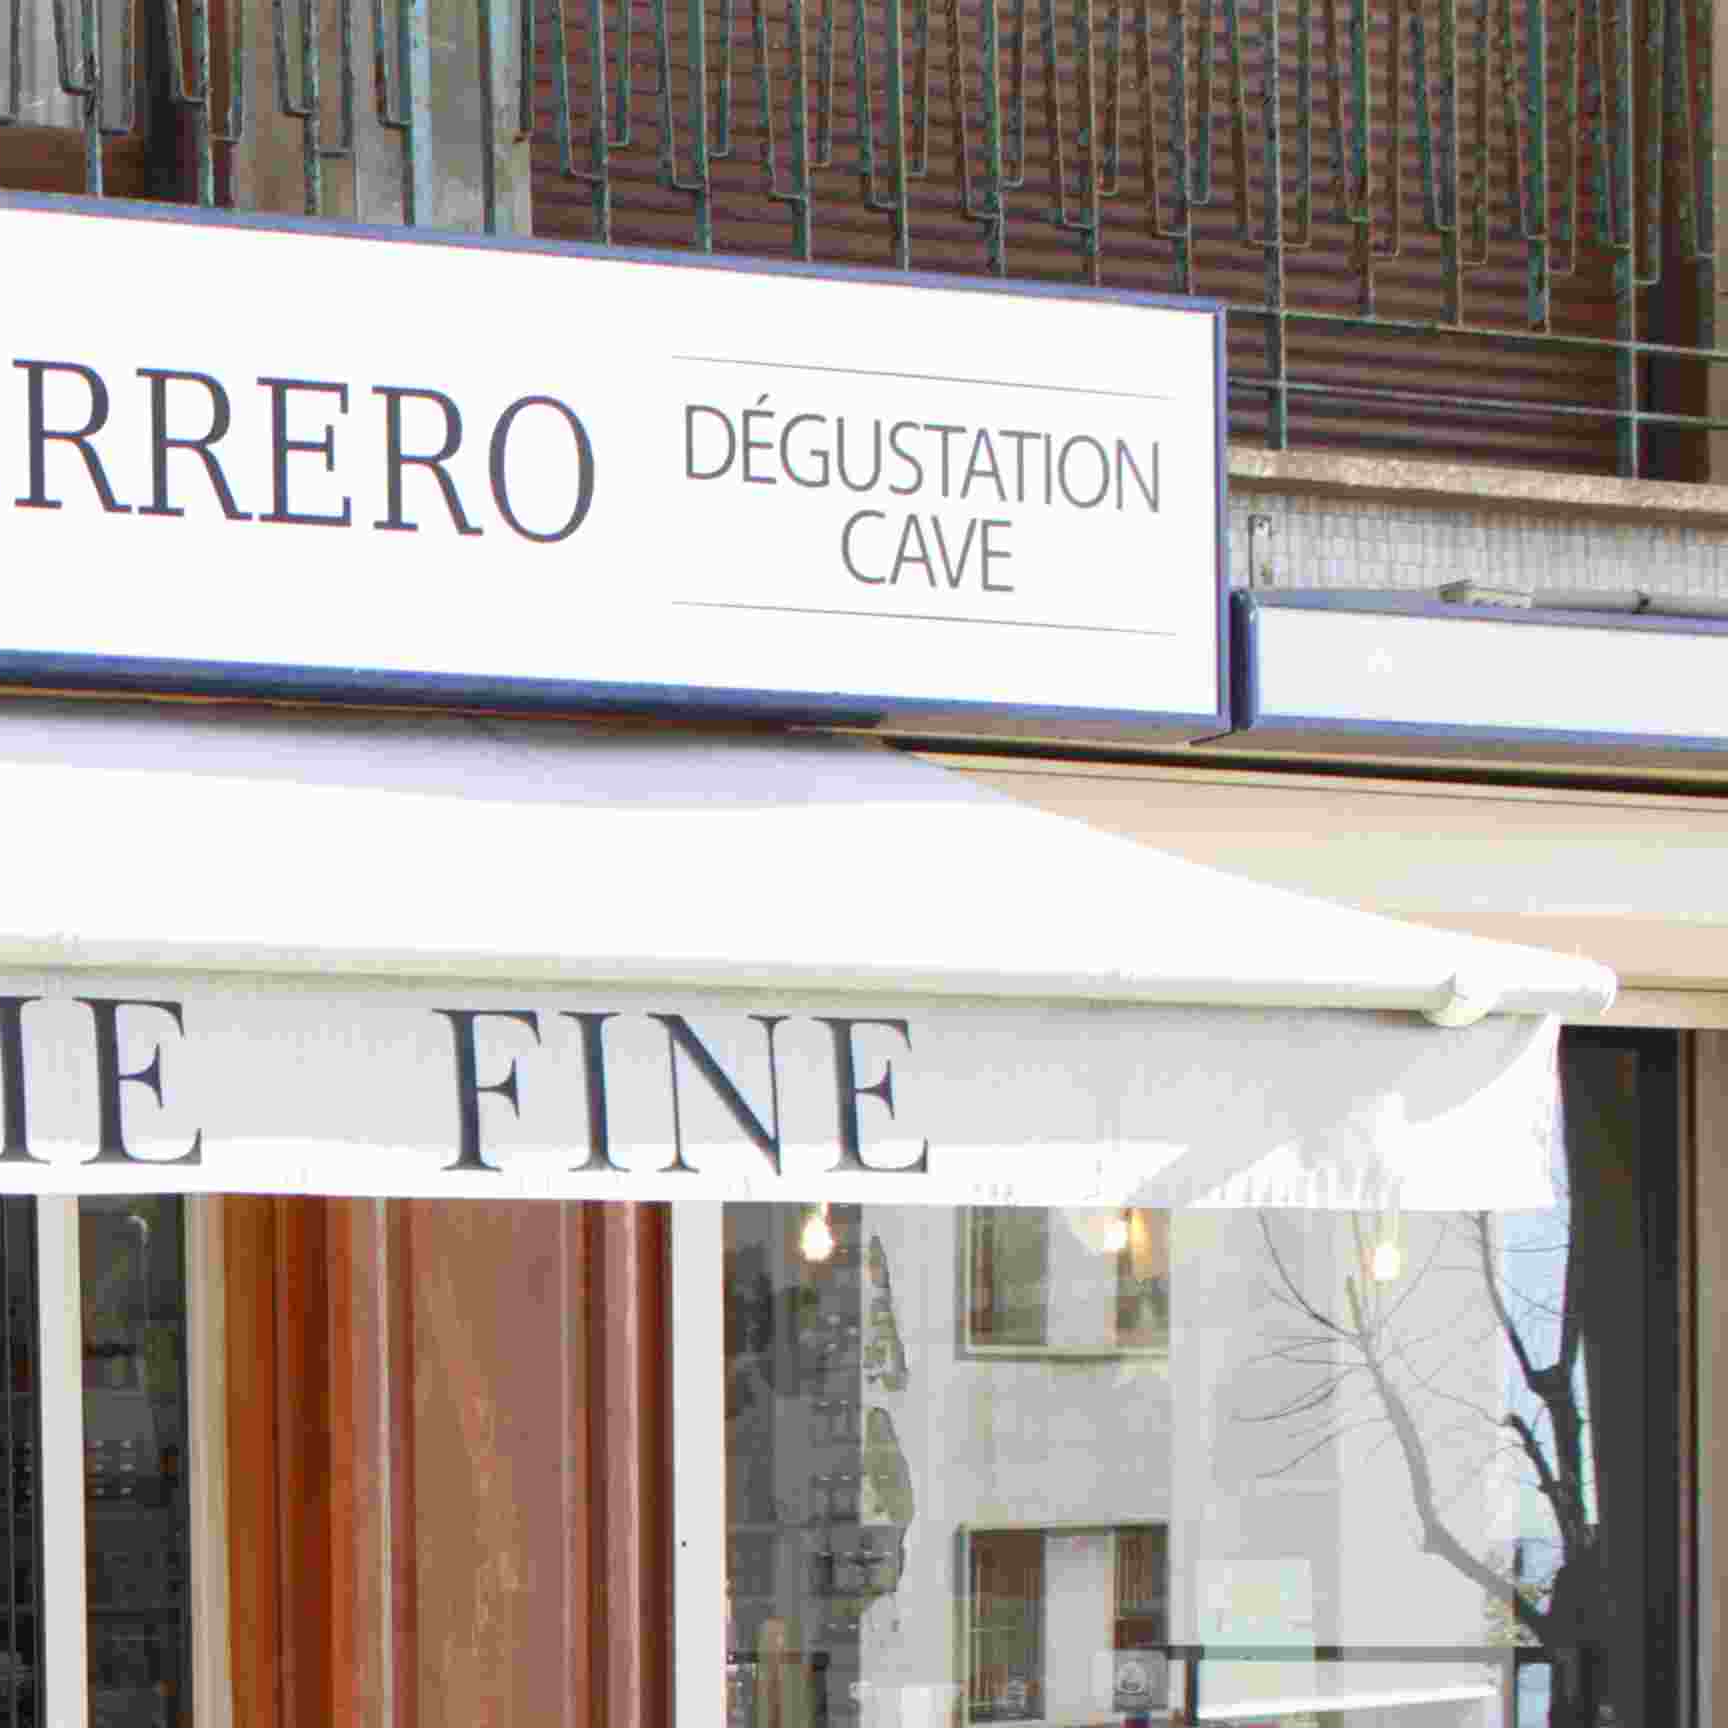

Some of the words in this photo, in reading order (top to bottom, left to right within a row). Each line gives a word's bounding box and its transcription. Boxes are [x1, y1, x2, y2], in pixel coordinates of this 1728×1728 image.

[685, 393, 1160, 513] DÉGUSTATION
[840, 509, 1014, 593] CAVE
[432, 1008, 928, 1176] FINE
